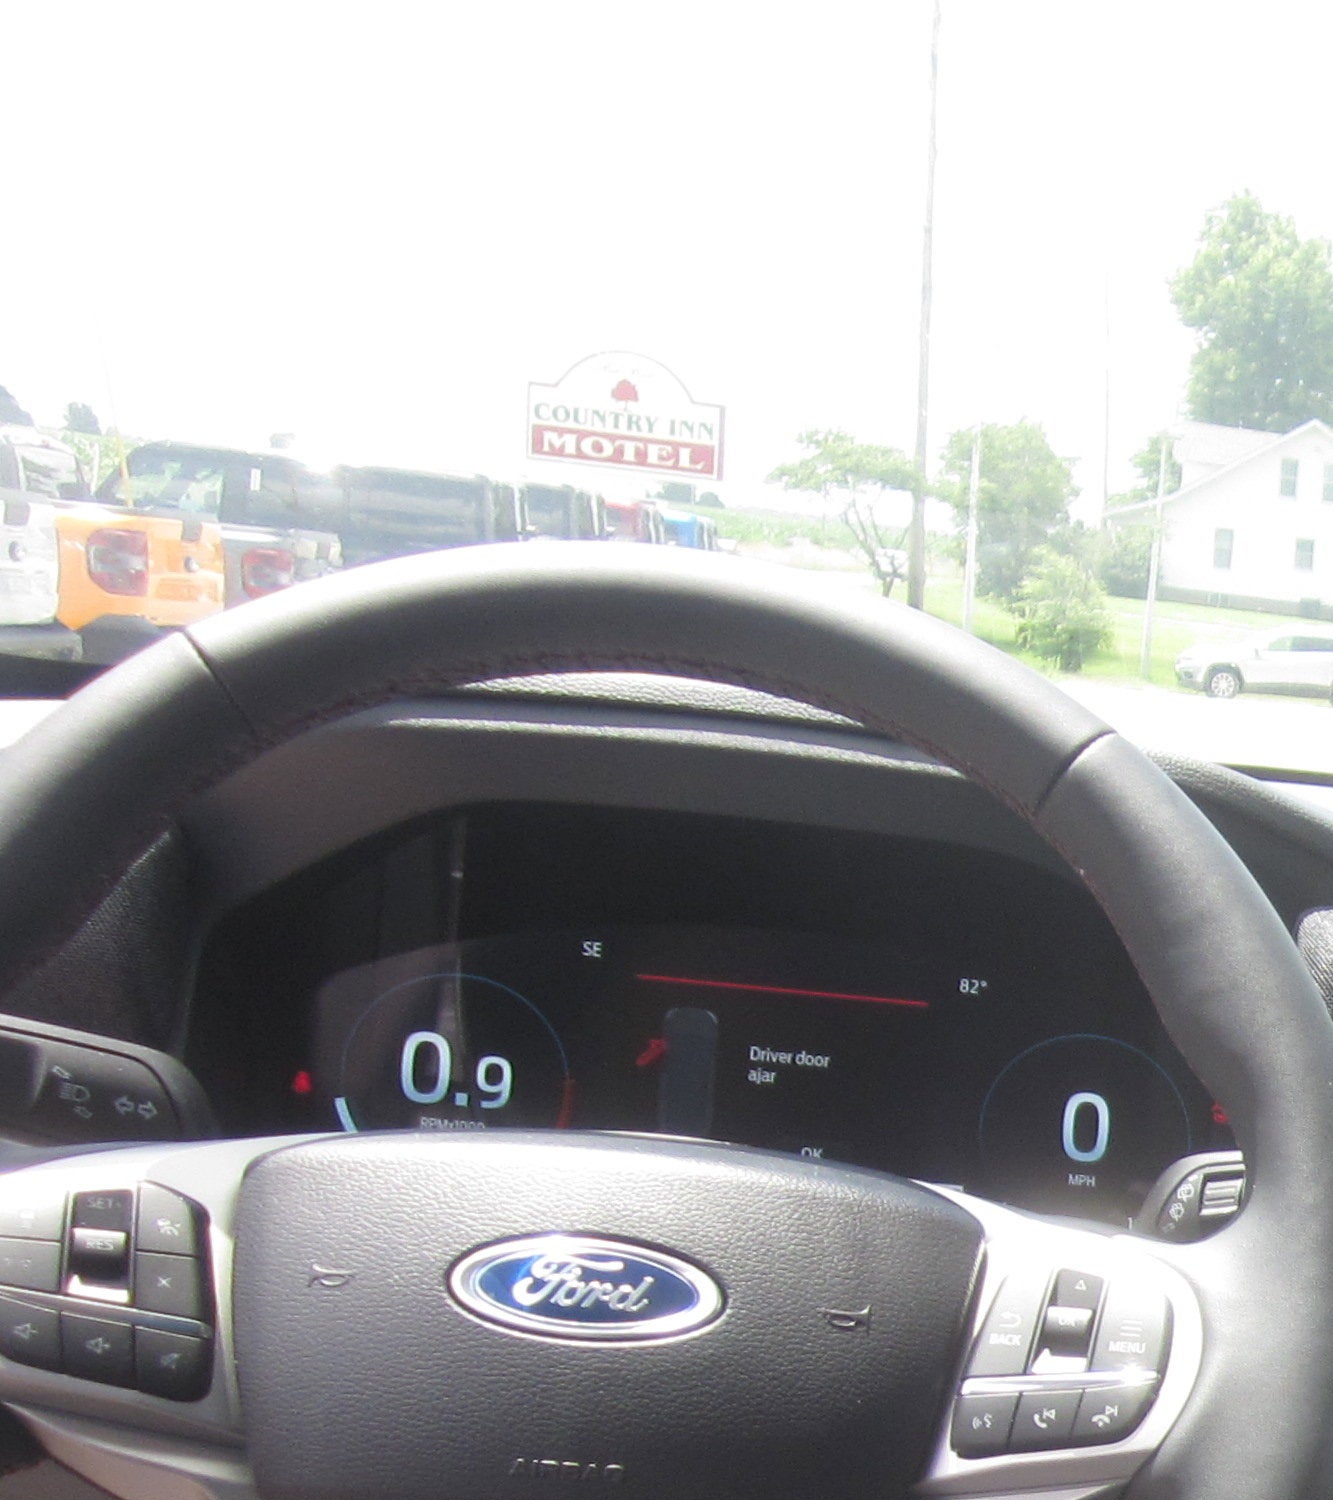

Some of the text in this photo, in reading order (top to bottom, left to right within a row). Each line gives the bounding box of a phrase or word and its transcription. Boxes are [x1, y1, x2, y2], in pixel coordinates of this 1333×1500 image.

[534, 402, 714, 441] COUNTRY INN
[541, 430, 707, 470] MOTEL
[582, 940, 602, 958] SE
[959, 977, 988, 995] 82°
[749, 1045, 831, 1068] Driver door
[401, 1030, 513, 1109] 0.9
[747, 1067, 777, 1086] ajar
[1061, 1091, 1111, 1163] 0
[801, 1146, 824, 1159] OK
[1068, 1173, 1096, 1188] MPH
[512, 1252, 655, 1313] Ford
[989, 1332, 1022, 1347] BACK
[1108, 1340, 1147, 1355] MENU
